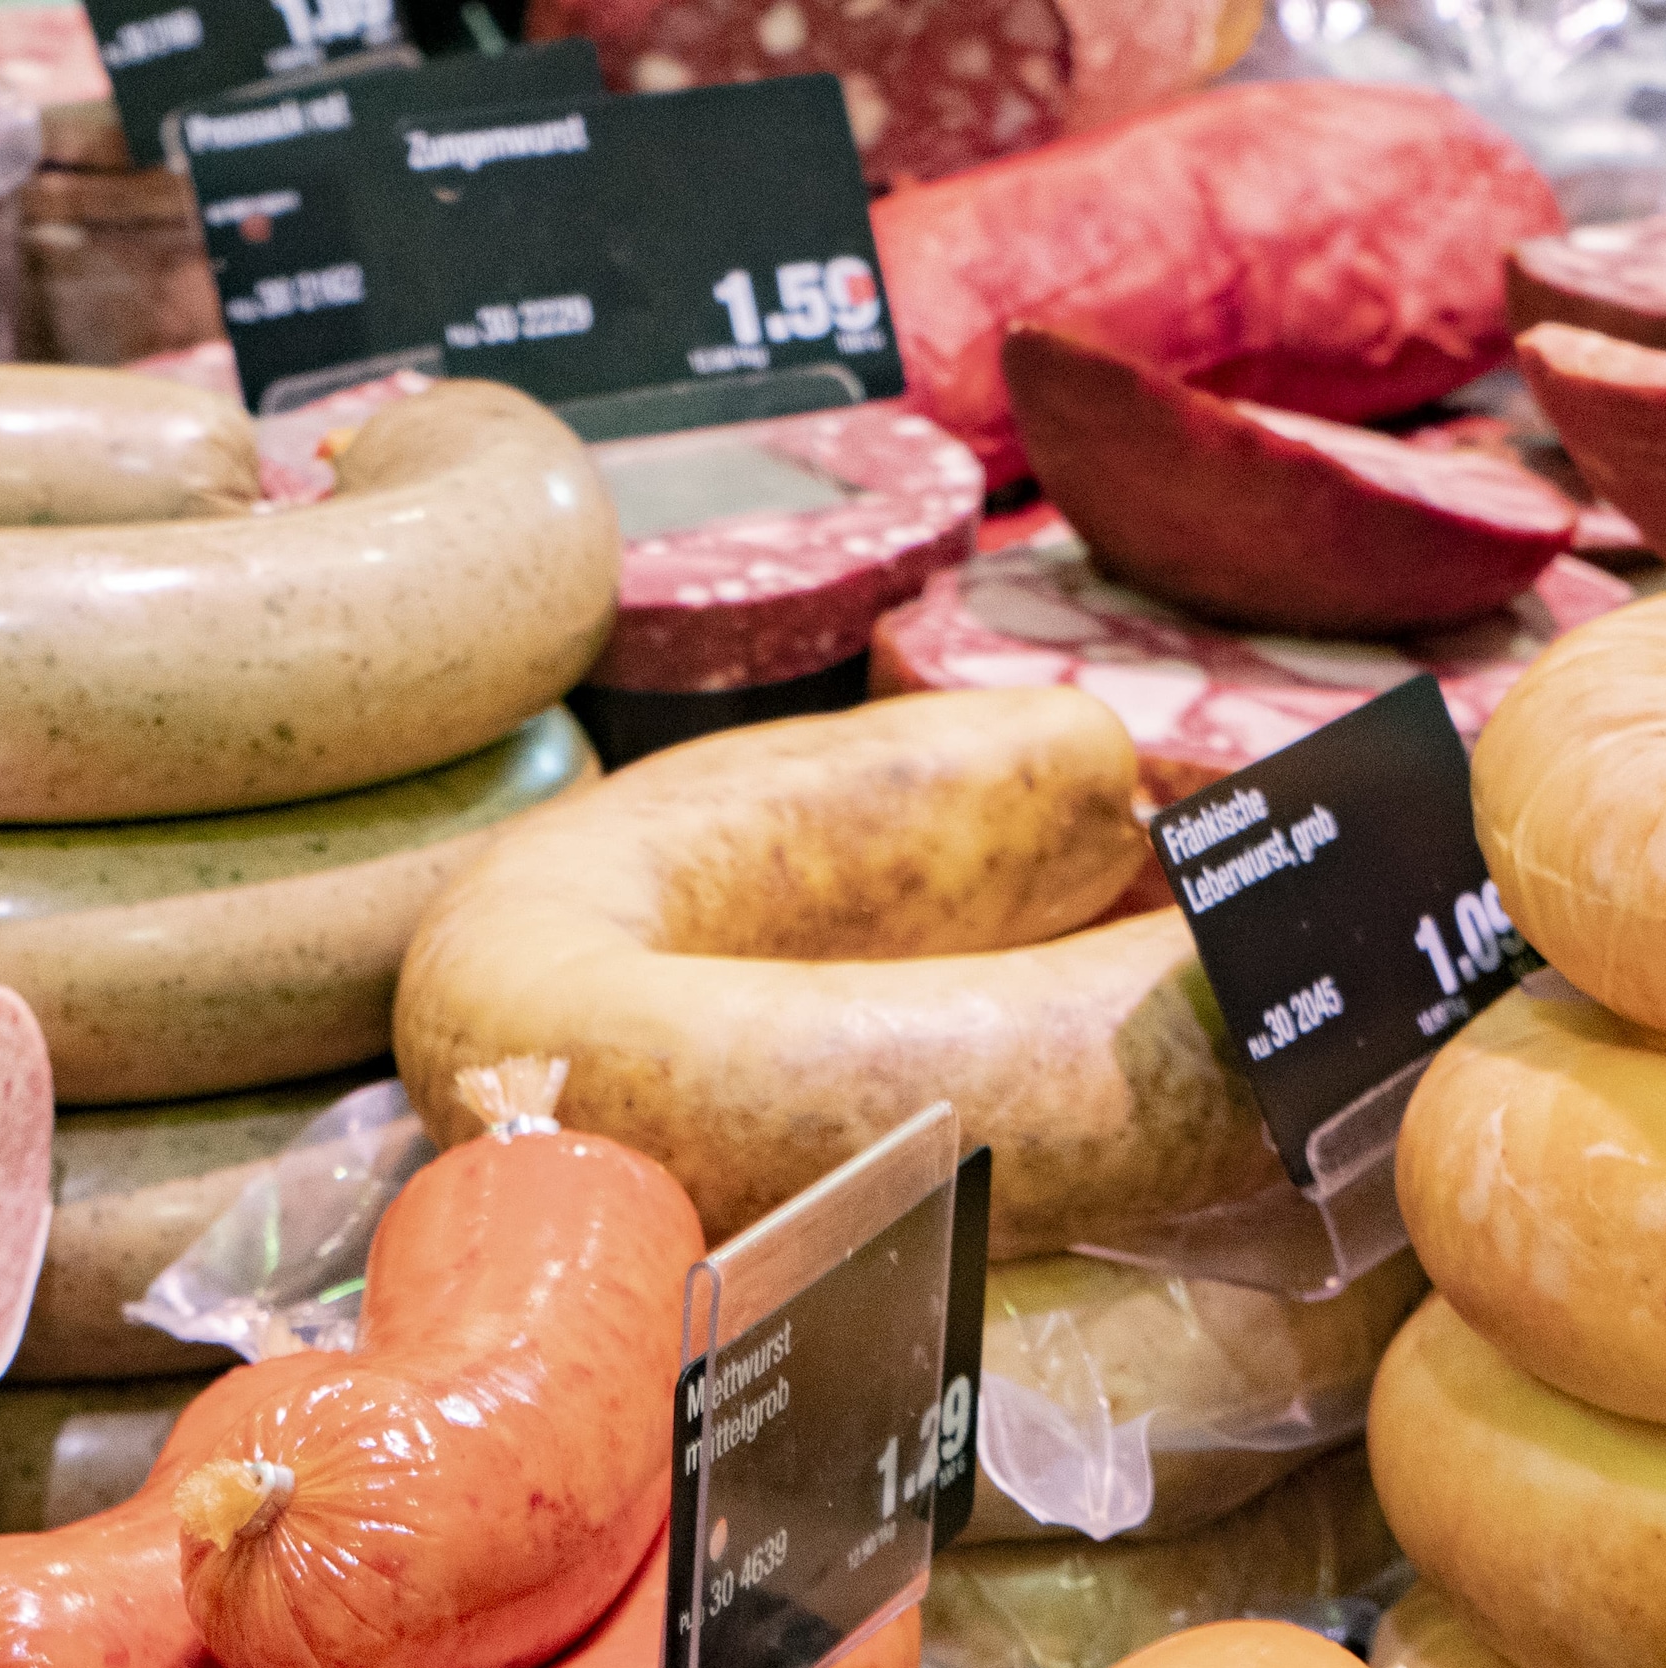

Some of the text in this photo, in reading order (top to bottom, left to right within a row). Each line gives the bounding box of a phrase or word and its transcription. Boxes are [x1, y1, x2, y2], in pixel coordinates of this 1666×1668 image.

[405, 112, 590, 171] Zungenwurst
[713, 255, 880, 343] 1.59
[1162, 787, 1267, 865] Fränkische
[1182, 804, 1339, 914] Leberwurst, grob
[1263, 1003, 1294, 1049] 30
[1290, 975, 1345, 1036] 2045
[686, 1320, 793, 1423] Mettwurst
[876, 1375, 971, 1521] 1.29
[708, 1571, 735, 1620] 30
[738, 1527, 789, 1592] 4639
